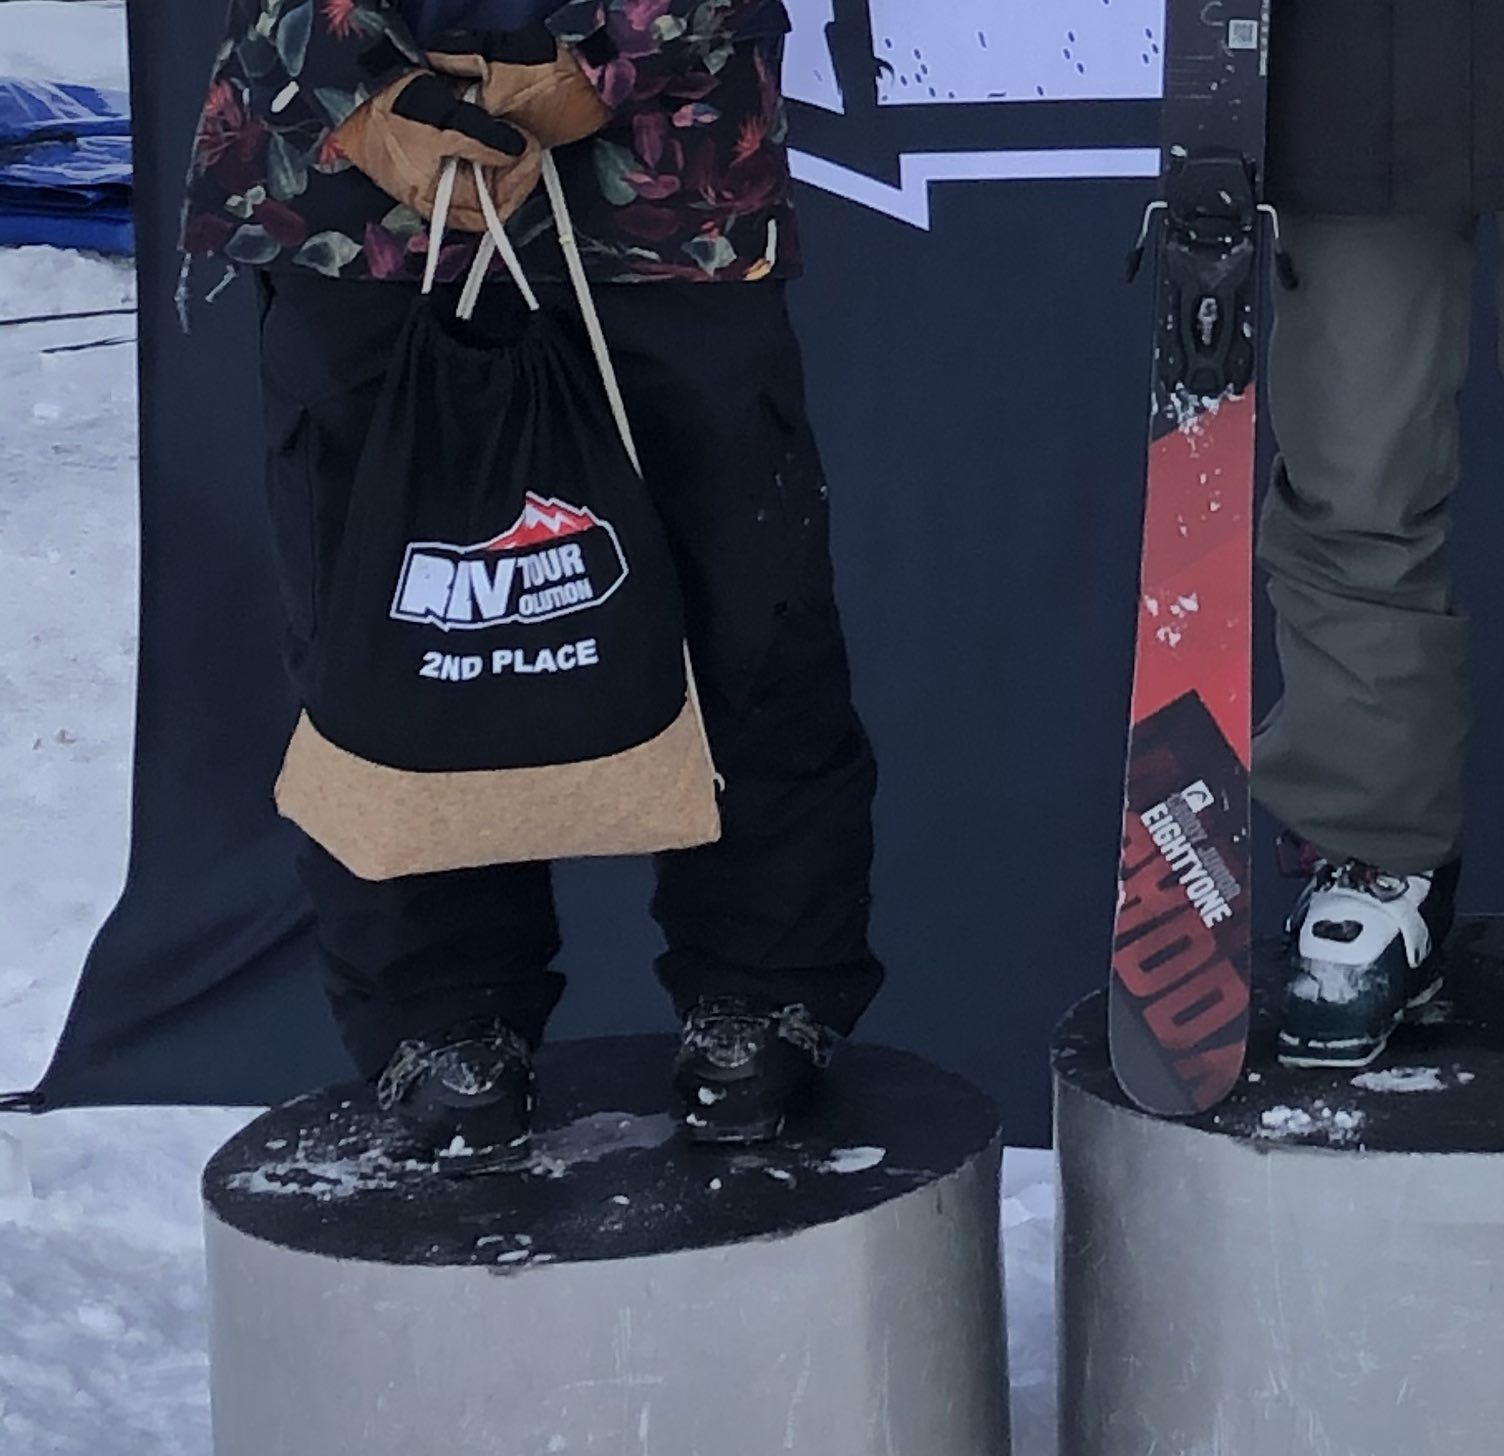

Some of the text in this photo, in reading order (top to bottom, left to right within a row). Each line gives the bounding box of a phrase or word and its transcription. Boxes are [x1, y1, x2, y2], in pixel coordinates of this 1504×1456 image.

[515, 543, 587, 590] TOUR
[518, 576, 595, 617] OLUTION
[418, 638, 600, 682] 2ND PLACE
[1139, 802, 1234, 929] EIGHTYONE
